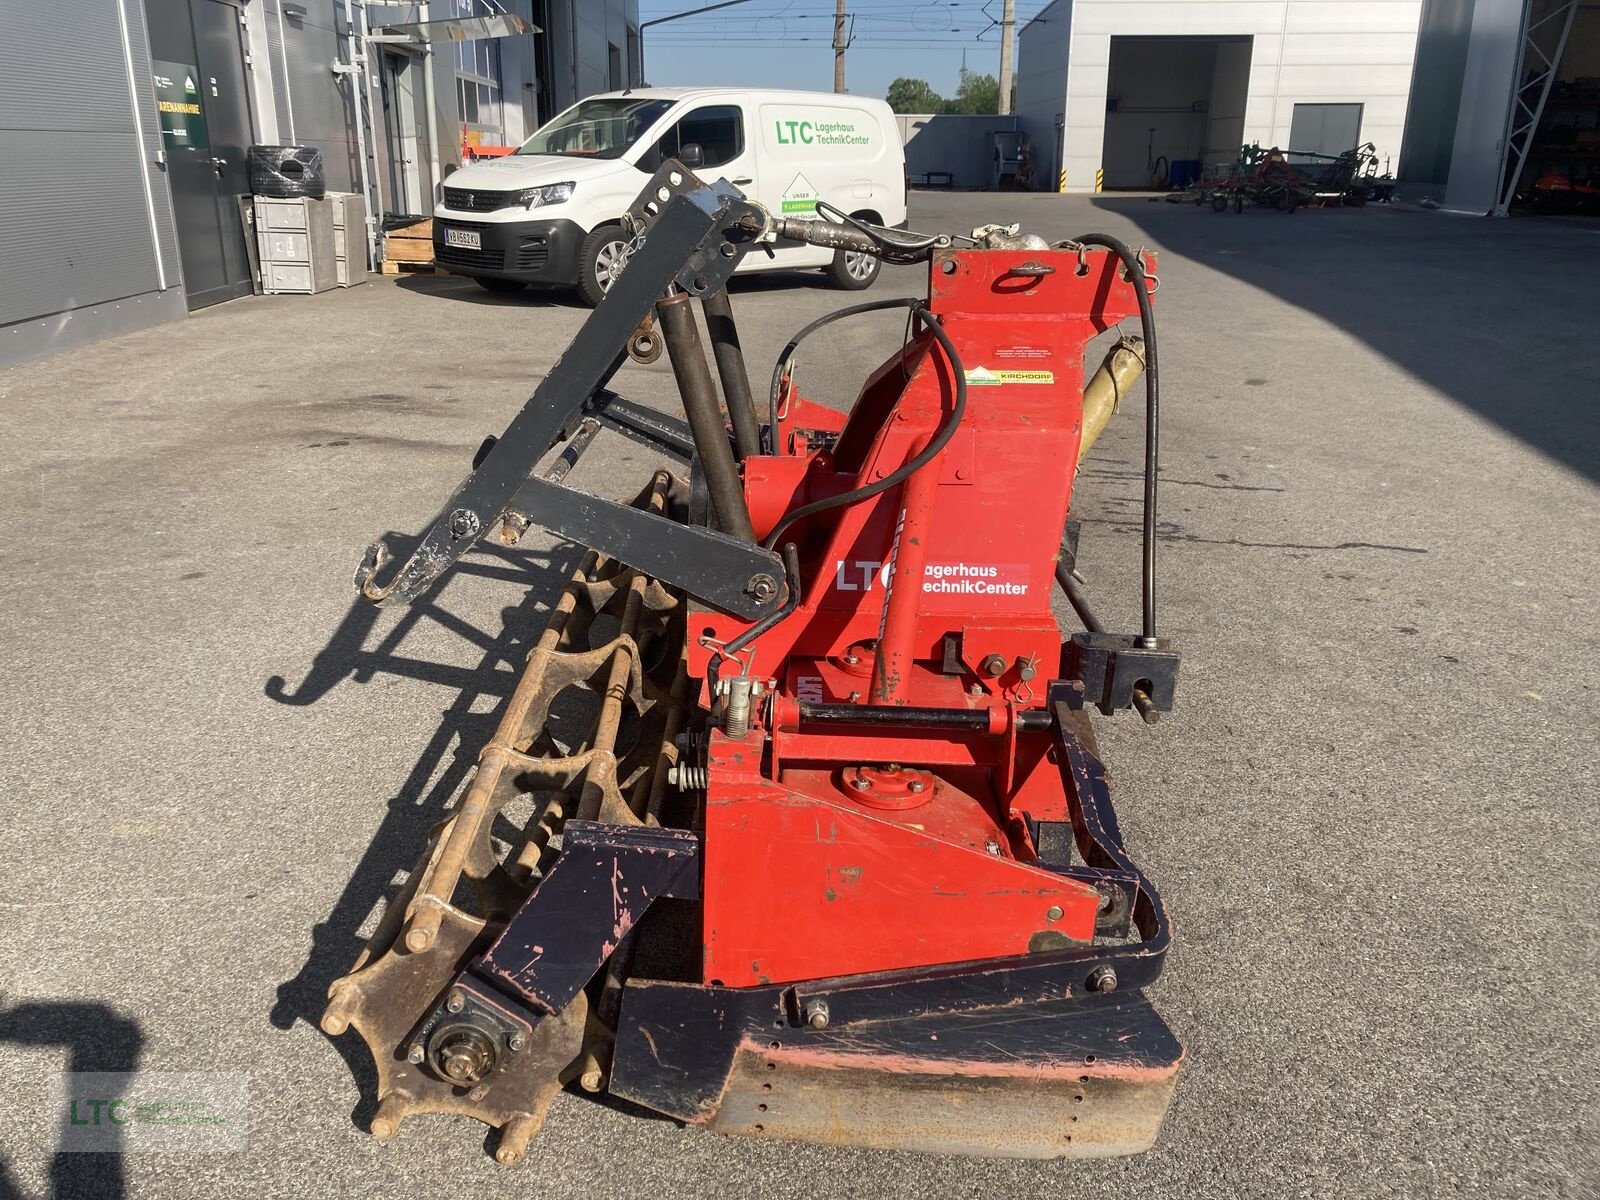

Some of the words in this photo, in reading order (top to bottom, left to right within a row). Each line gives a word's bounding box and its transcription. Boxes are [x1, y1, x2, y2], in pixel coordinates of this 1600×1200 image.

[158, 101, 200, 114] ARENANNAHME
[776, 121, 813, 144] LTC
[815, 121, 854, 133] Lagerhaus
[816, 134, 869, 144] TechnikCenter
[925, 563, 998, 577] agerhaus
[923, 579, 1028, 595] echnikCenter
